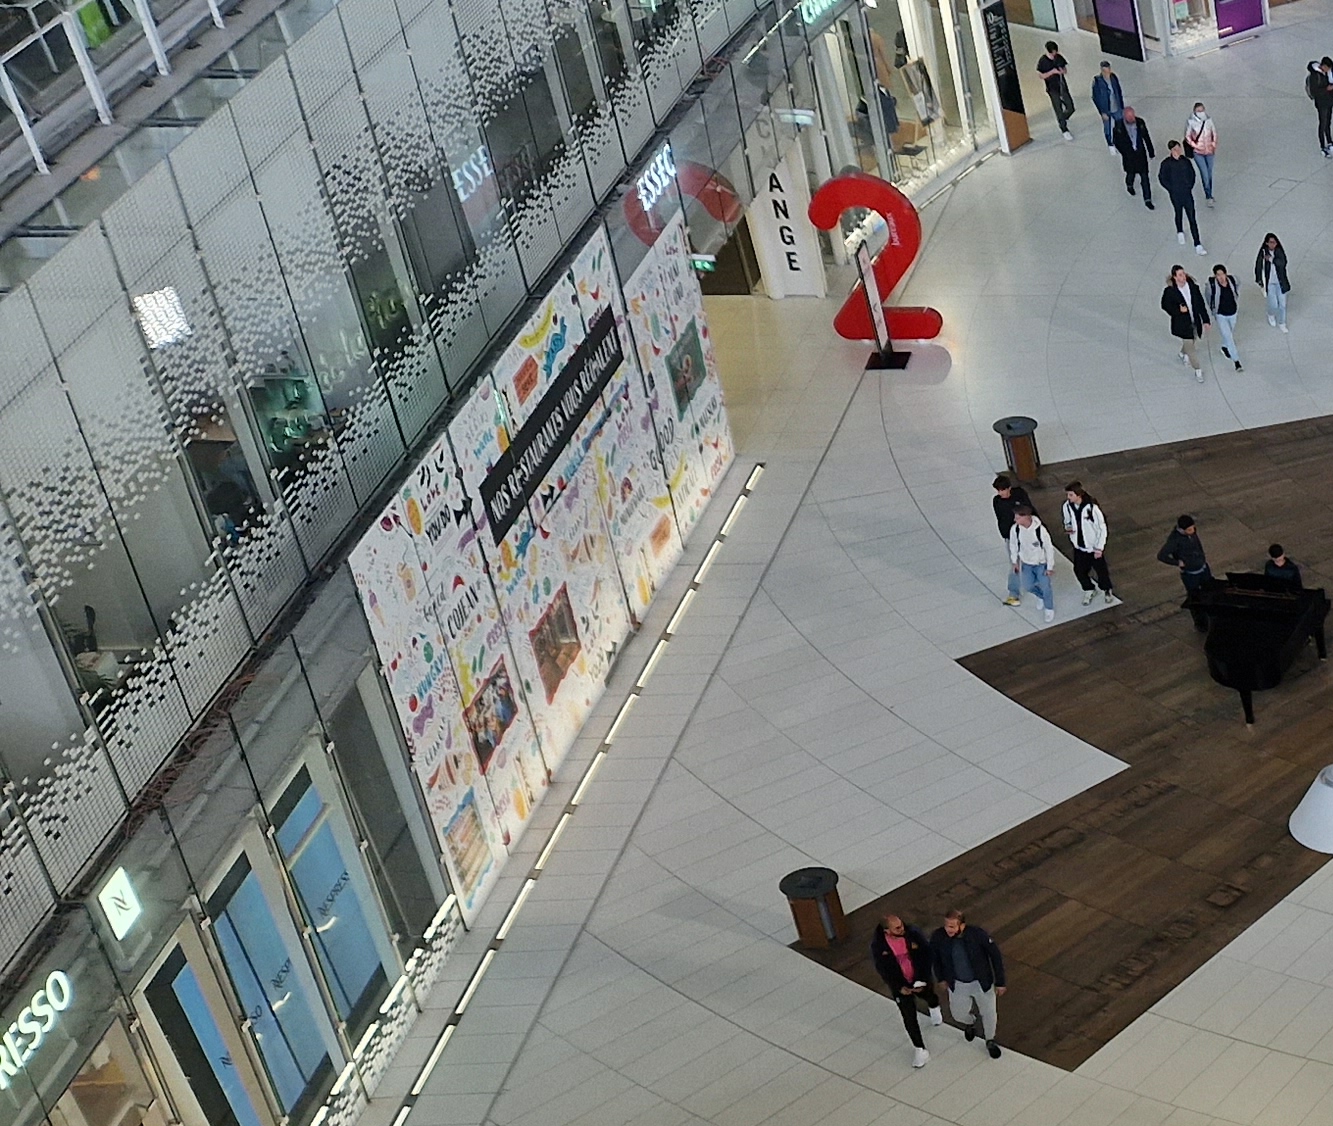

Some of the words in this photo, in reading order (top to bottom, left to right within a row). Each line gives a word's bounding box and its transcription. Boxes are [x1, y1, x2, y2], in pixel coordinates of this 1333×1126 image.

[490, 482, 511, 524] NOS
[507, 406, 565, 500] RESTAURANTS
[561, 376, 584, 421] VOUS
